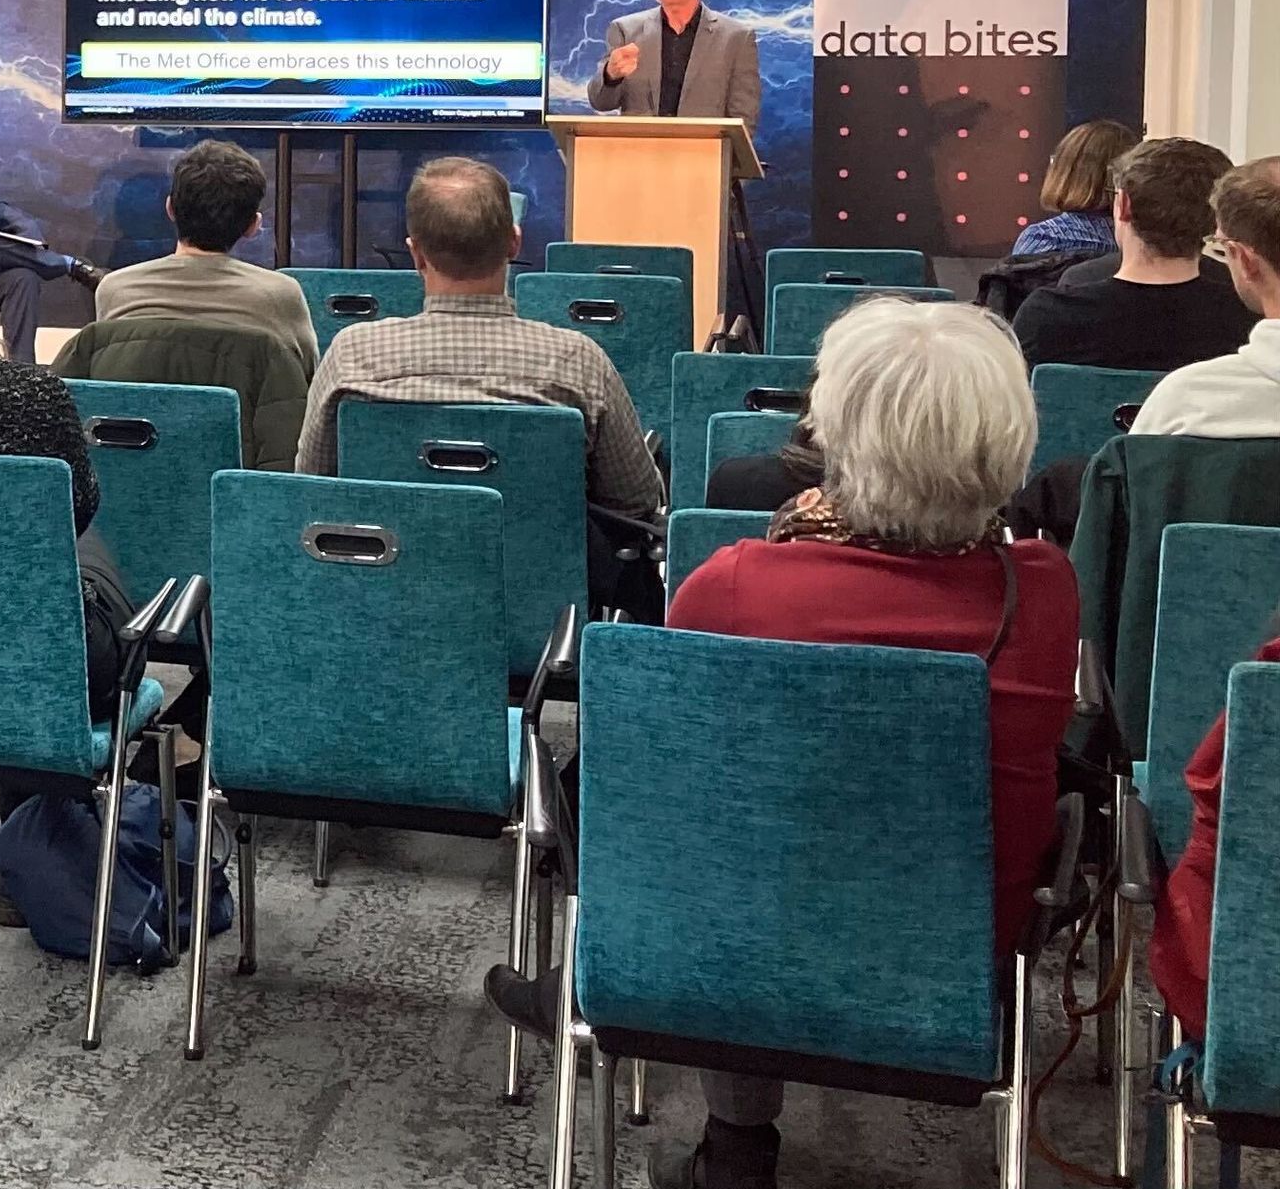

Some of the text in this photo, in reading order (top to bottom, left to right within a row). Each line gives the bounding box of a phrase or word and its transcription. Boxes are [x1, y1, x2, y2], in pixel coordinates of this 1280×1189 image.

[96, 7, 322, 27] and model the climate.
[820, 19, 1058, 57] data bites
[117, 52, 502, 73] The Met Office embraces this technology
